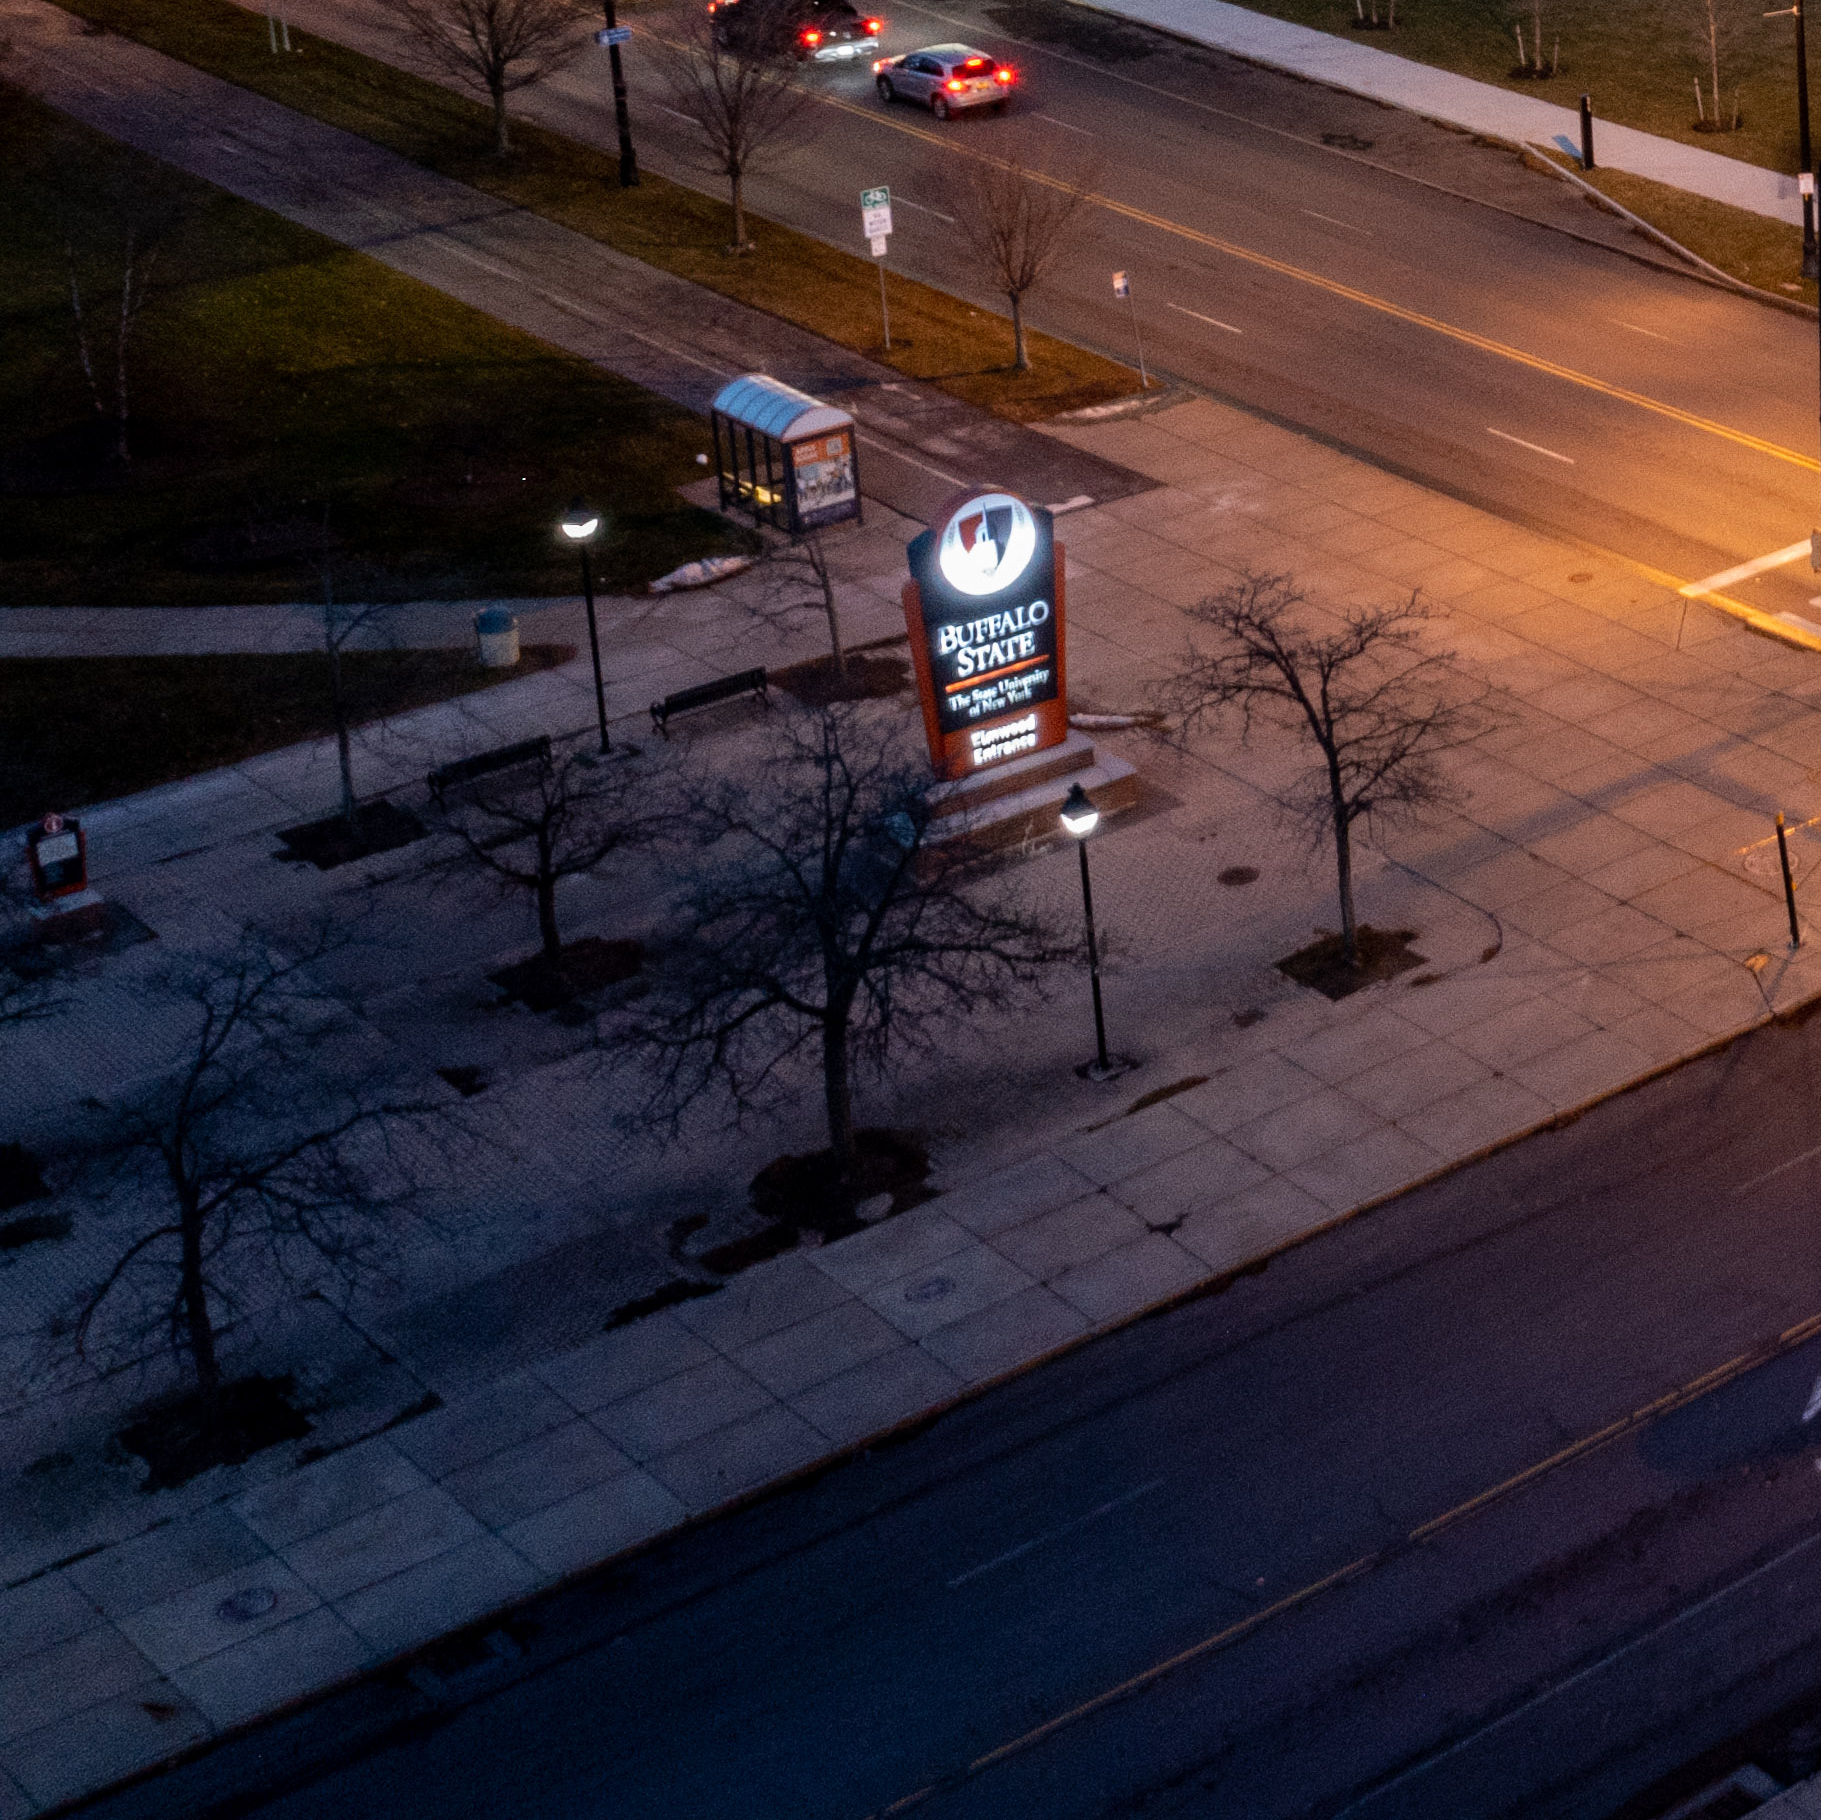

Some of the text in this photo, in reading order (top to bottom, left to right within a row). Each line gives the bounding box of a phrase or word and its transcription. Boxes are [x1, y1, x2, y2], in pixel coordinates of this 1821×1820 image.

[939, 600, 1049, 655] BUFFALO
[957, 630, 1036, 678] STATE
[949, 668, 1050, 712] The State University
[969, 686, 1033, 718] of New York
[971, 713, 1037, 747] Elmwood
[973, 733, 1036, 765] Entrance
